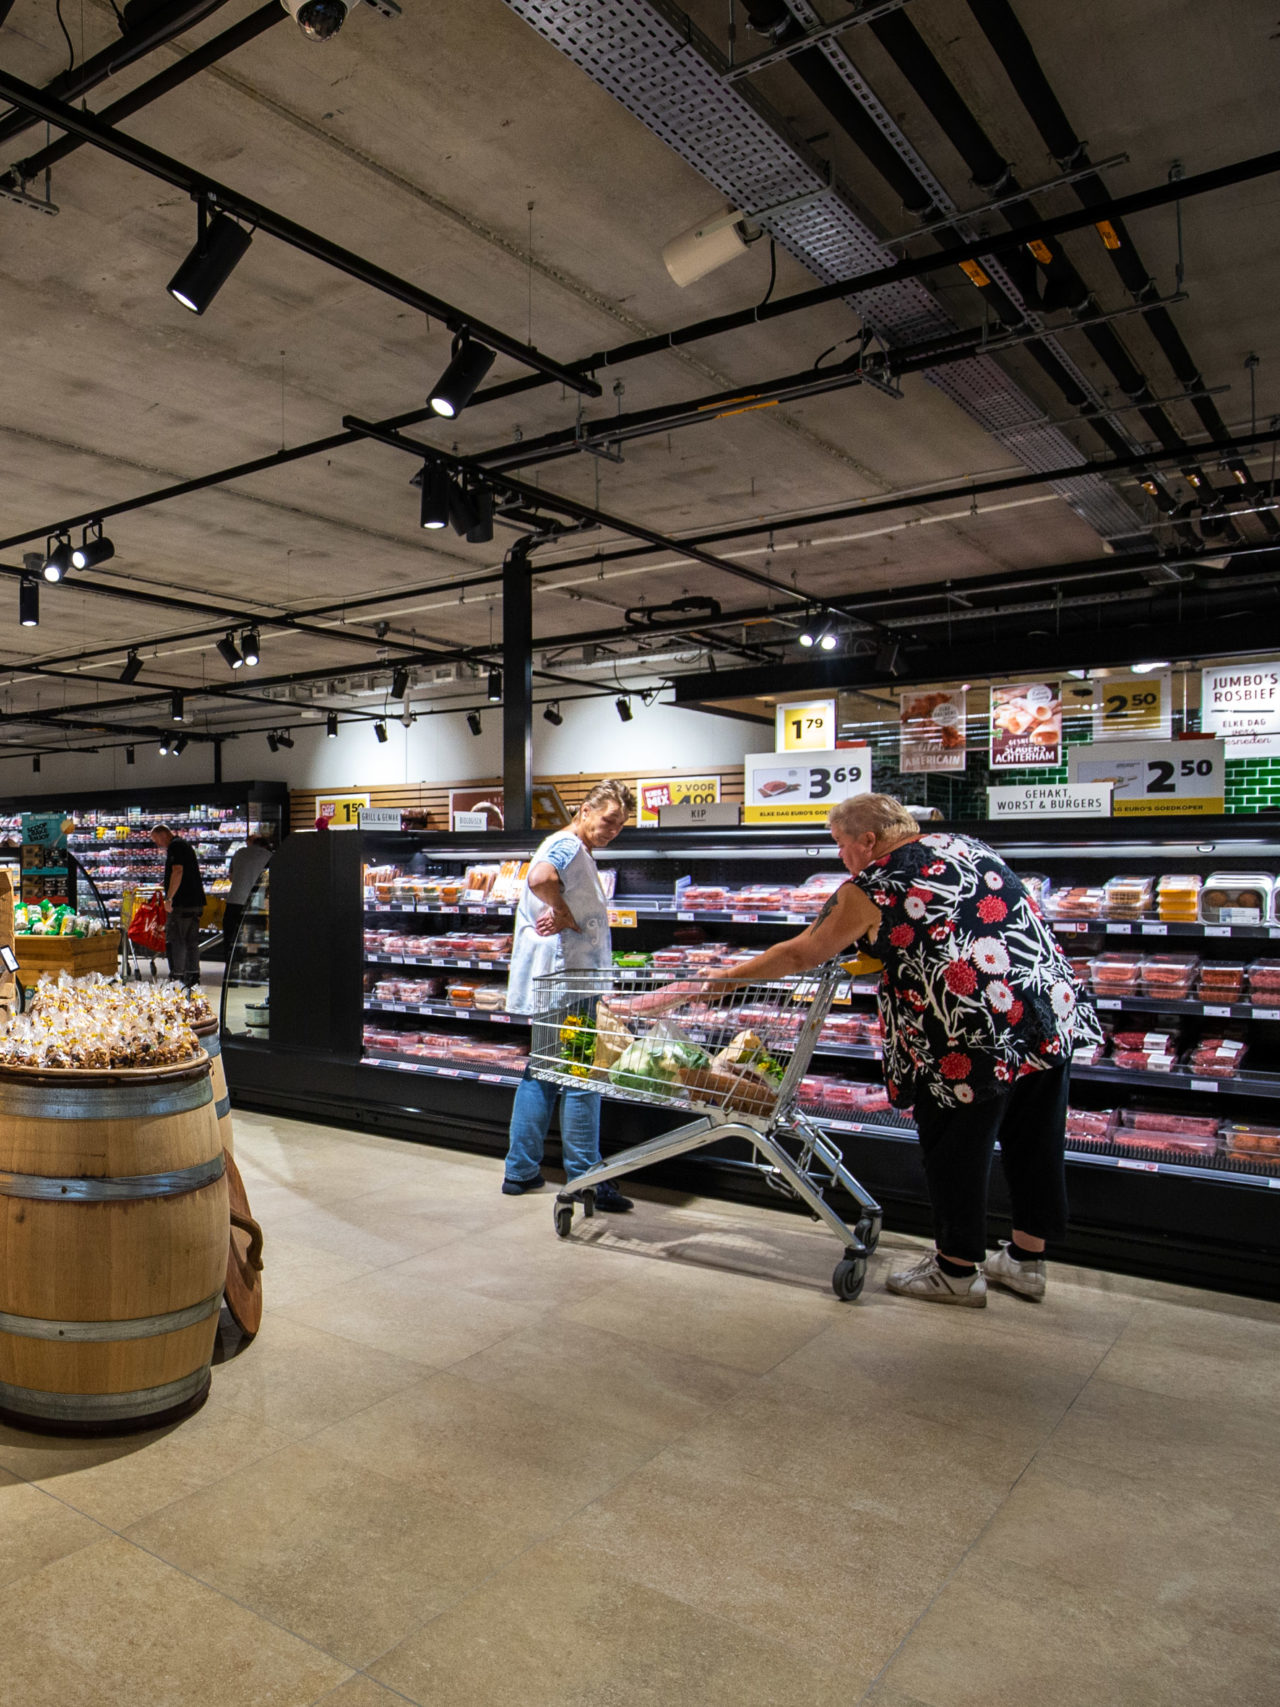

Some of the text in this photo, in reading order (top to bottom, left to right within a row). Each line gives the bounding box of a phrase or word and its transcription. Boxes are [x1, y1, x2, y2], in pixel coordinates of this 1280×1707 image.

[1213, 673, 1279, 690] JUMBO'S
[1214, 688, 1276, 702] ROSBIEF
[1222, 718, 1266, 728] ELKE DAG
[1225, 733, 1271, 745] esneden
[1005, 745, 1046, 754] SLAGERS
[905, 755, 960, 768] AMERICAIN
[995, 751, 1055, 763] ACHTERHAM
[676, 783, 715, 792] 2 VOOR
[1025, 788, 1072, 799] GEHAKT,
[997, 798, 1102, 811] WORST & BURGERS
[362, 813, 376, 822] GRILL
[382, 812, 399, 821] GEMAK
[691, 809, 707, 818] KIP
